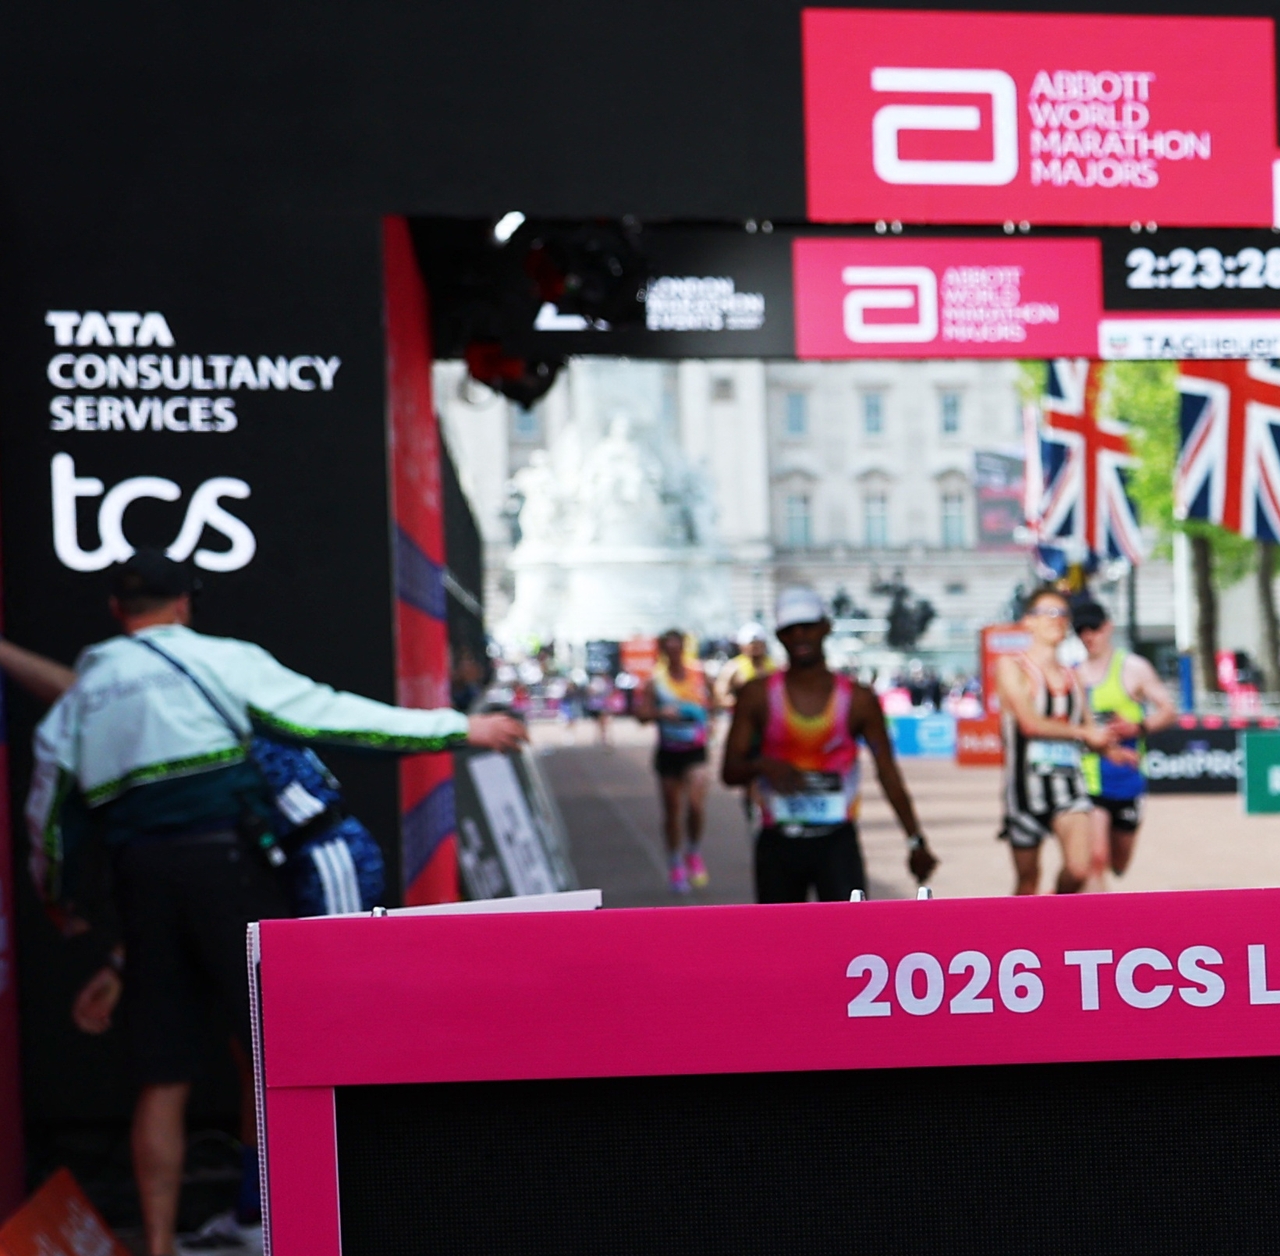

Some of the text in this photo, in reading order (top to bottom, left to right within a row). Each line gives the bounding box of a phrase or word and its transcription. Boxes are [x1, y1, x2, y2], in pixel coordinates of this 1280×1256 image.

[1028, 70, 1156, 101] ABBOTT
[1028, 100, 1149, 130] WORLD
[1029, 129, 1211, 160] MARATHON
[1030, 158, 1159, 188] MAJORS
[46, 311, 174, 346] TATA
[48, 355, 340, 391] CONSULTANCY
[50, 397, 238, 432] SERVICES
[51, 452, 256, 572] tcs
[846, 948, 1043, 1018] 2026
[1065, 943, 1225, 1010] TCS
